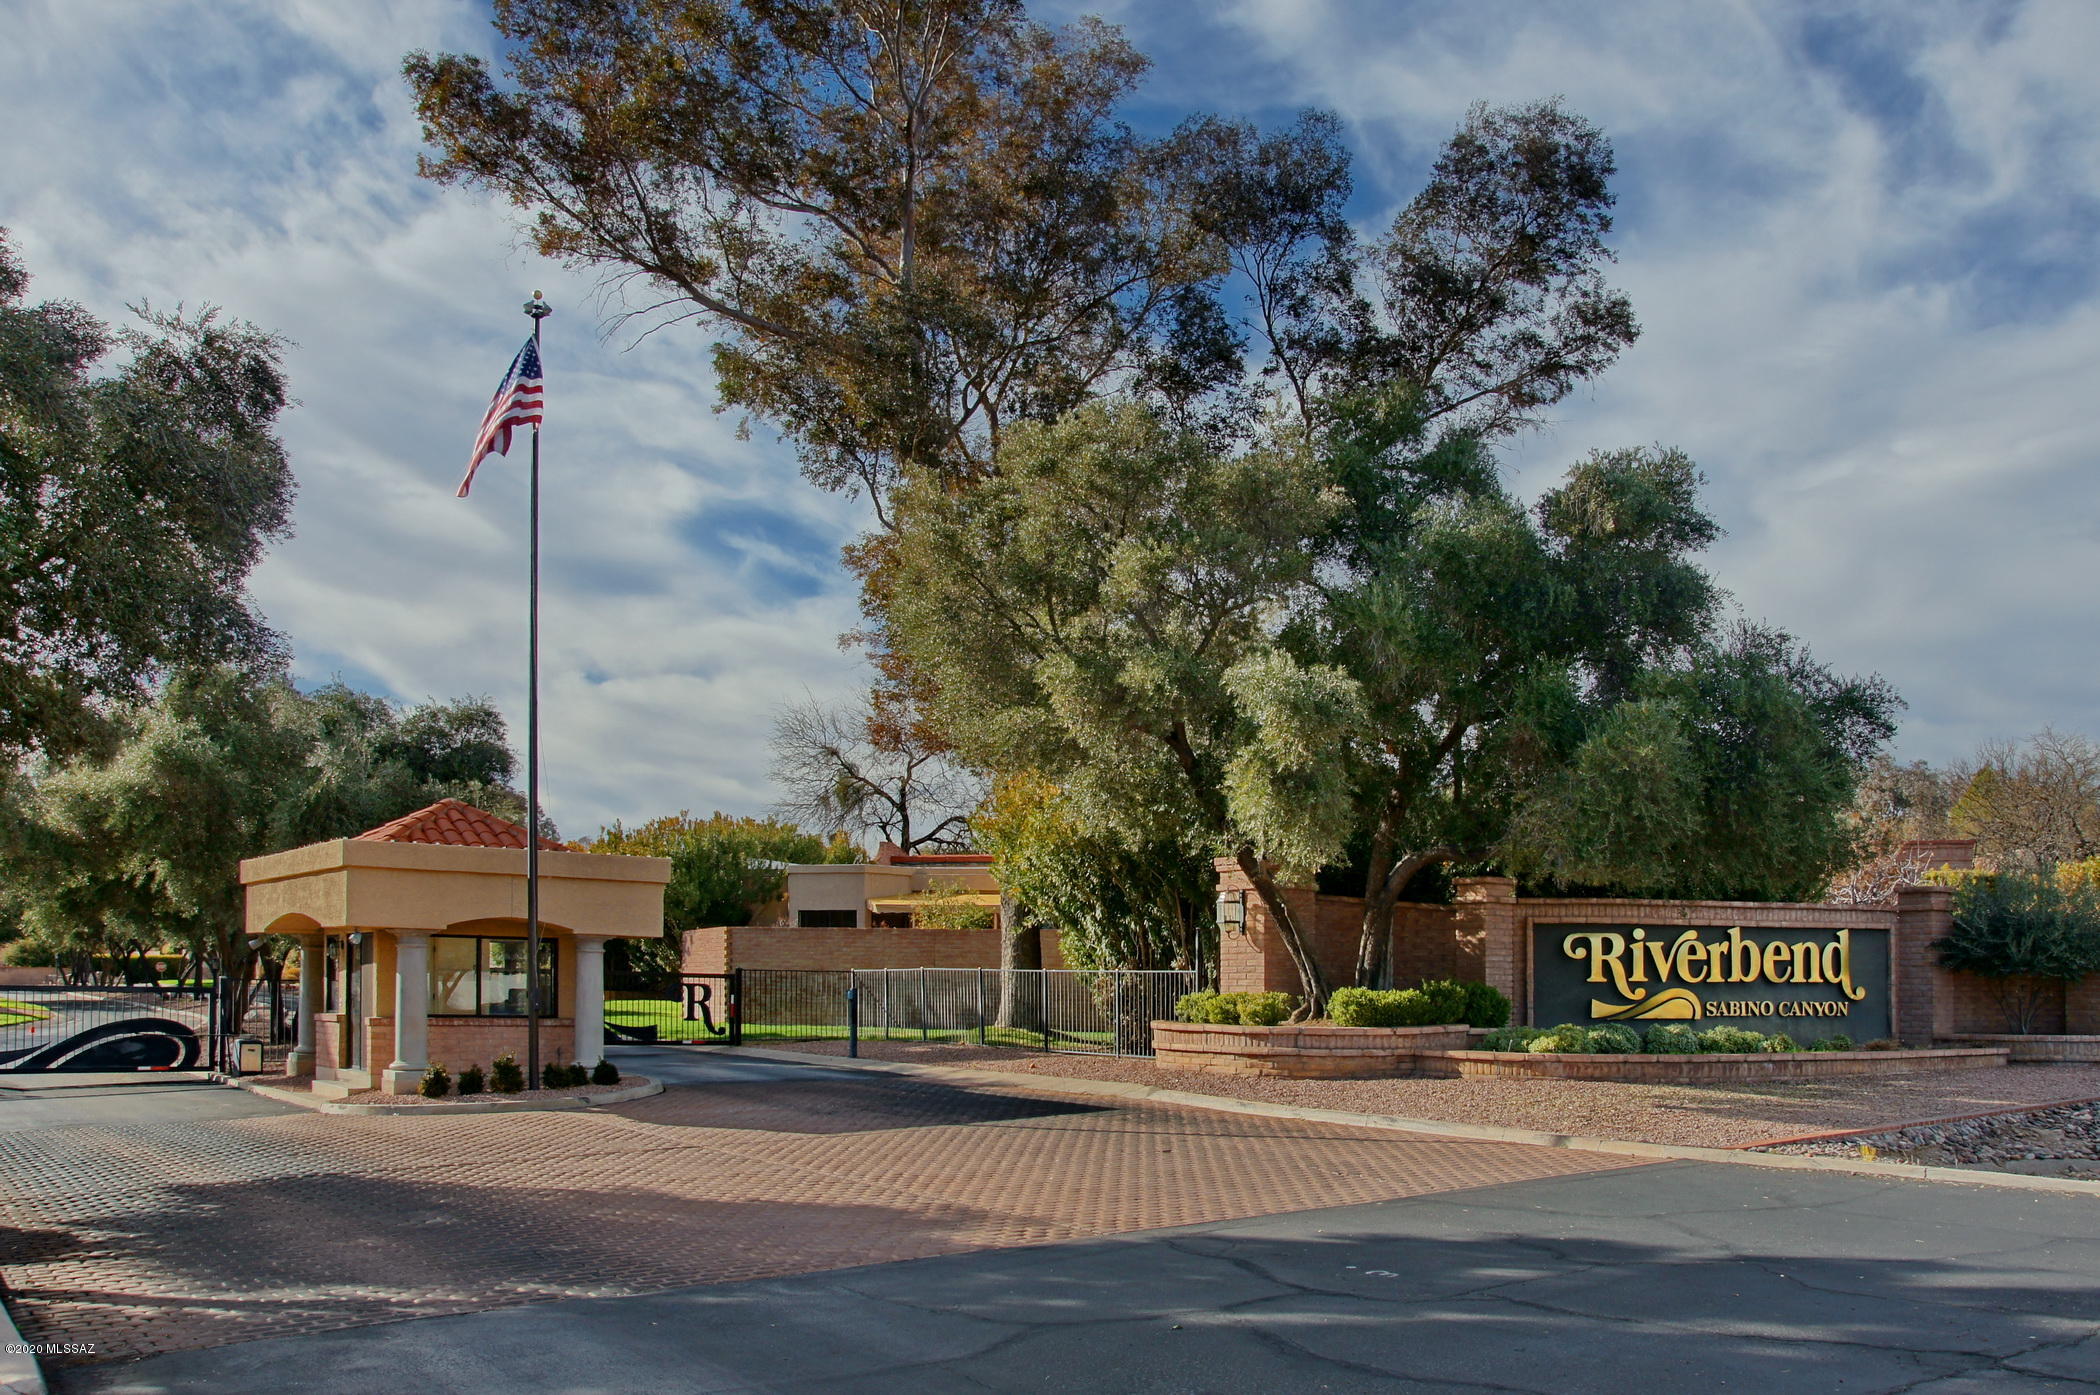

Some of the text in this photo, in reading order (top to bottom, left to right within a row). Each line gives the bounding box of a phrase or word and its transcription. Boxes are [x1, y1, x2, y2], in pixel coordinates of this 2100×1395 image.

[1562, 927, 1866, 1001] Riverbend
[664, 983, 726, 1036] R
[1706, 1000, 1848, 1017] SABINO CANYON
